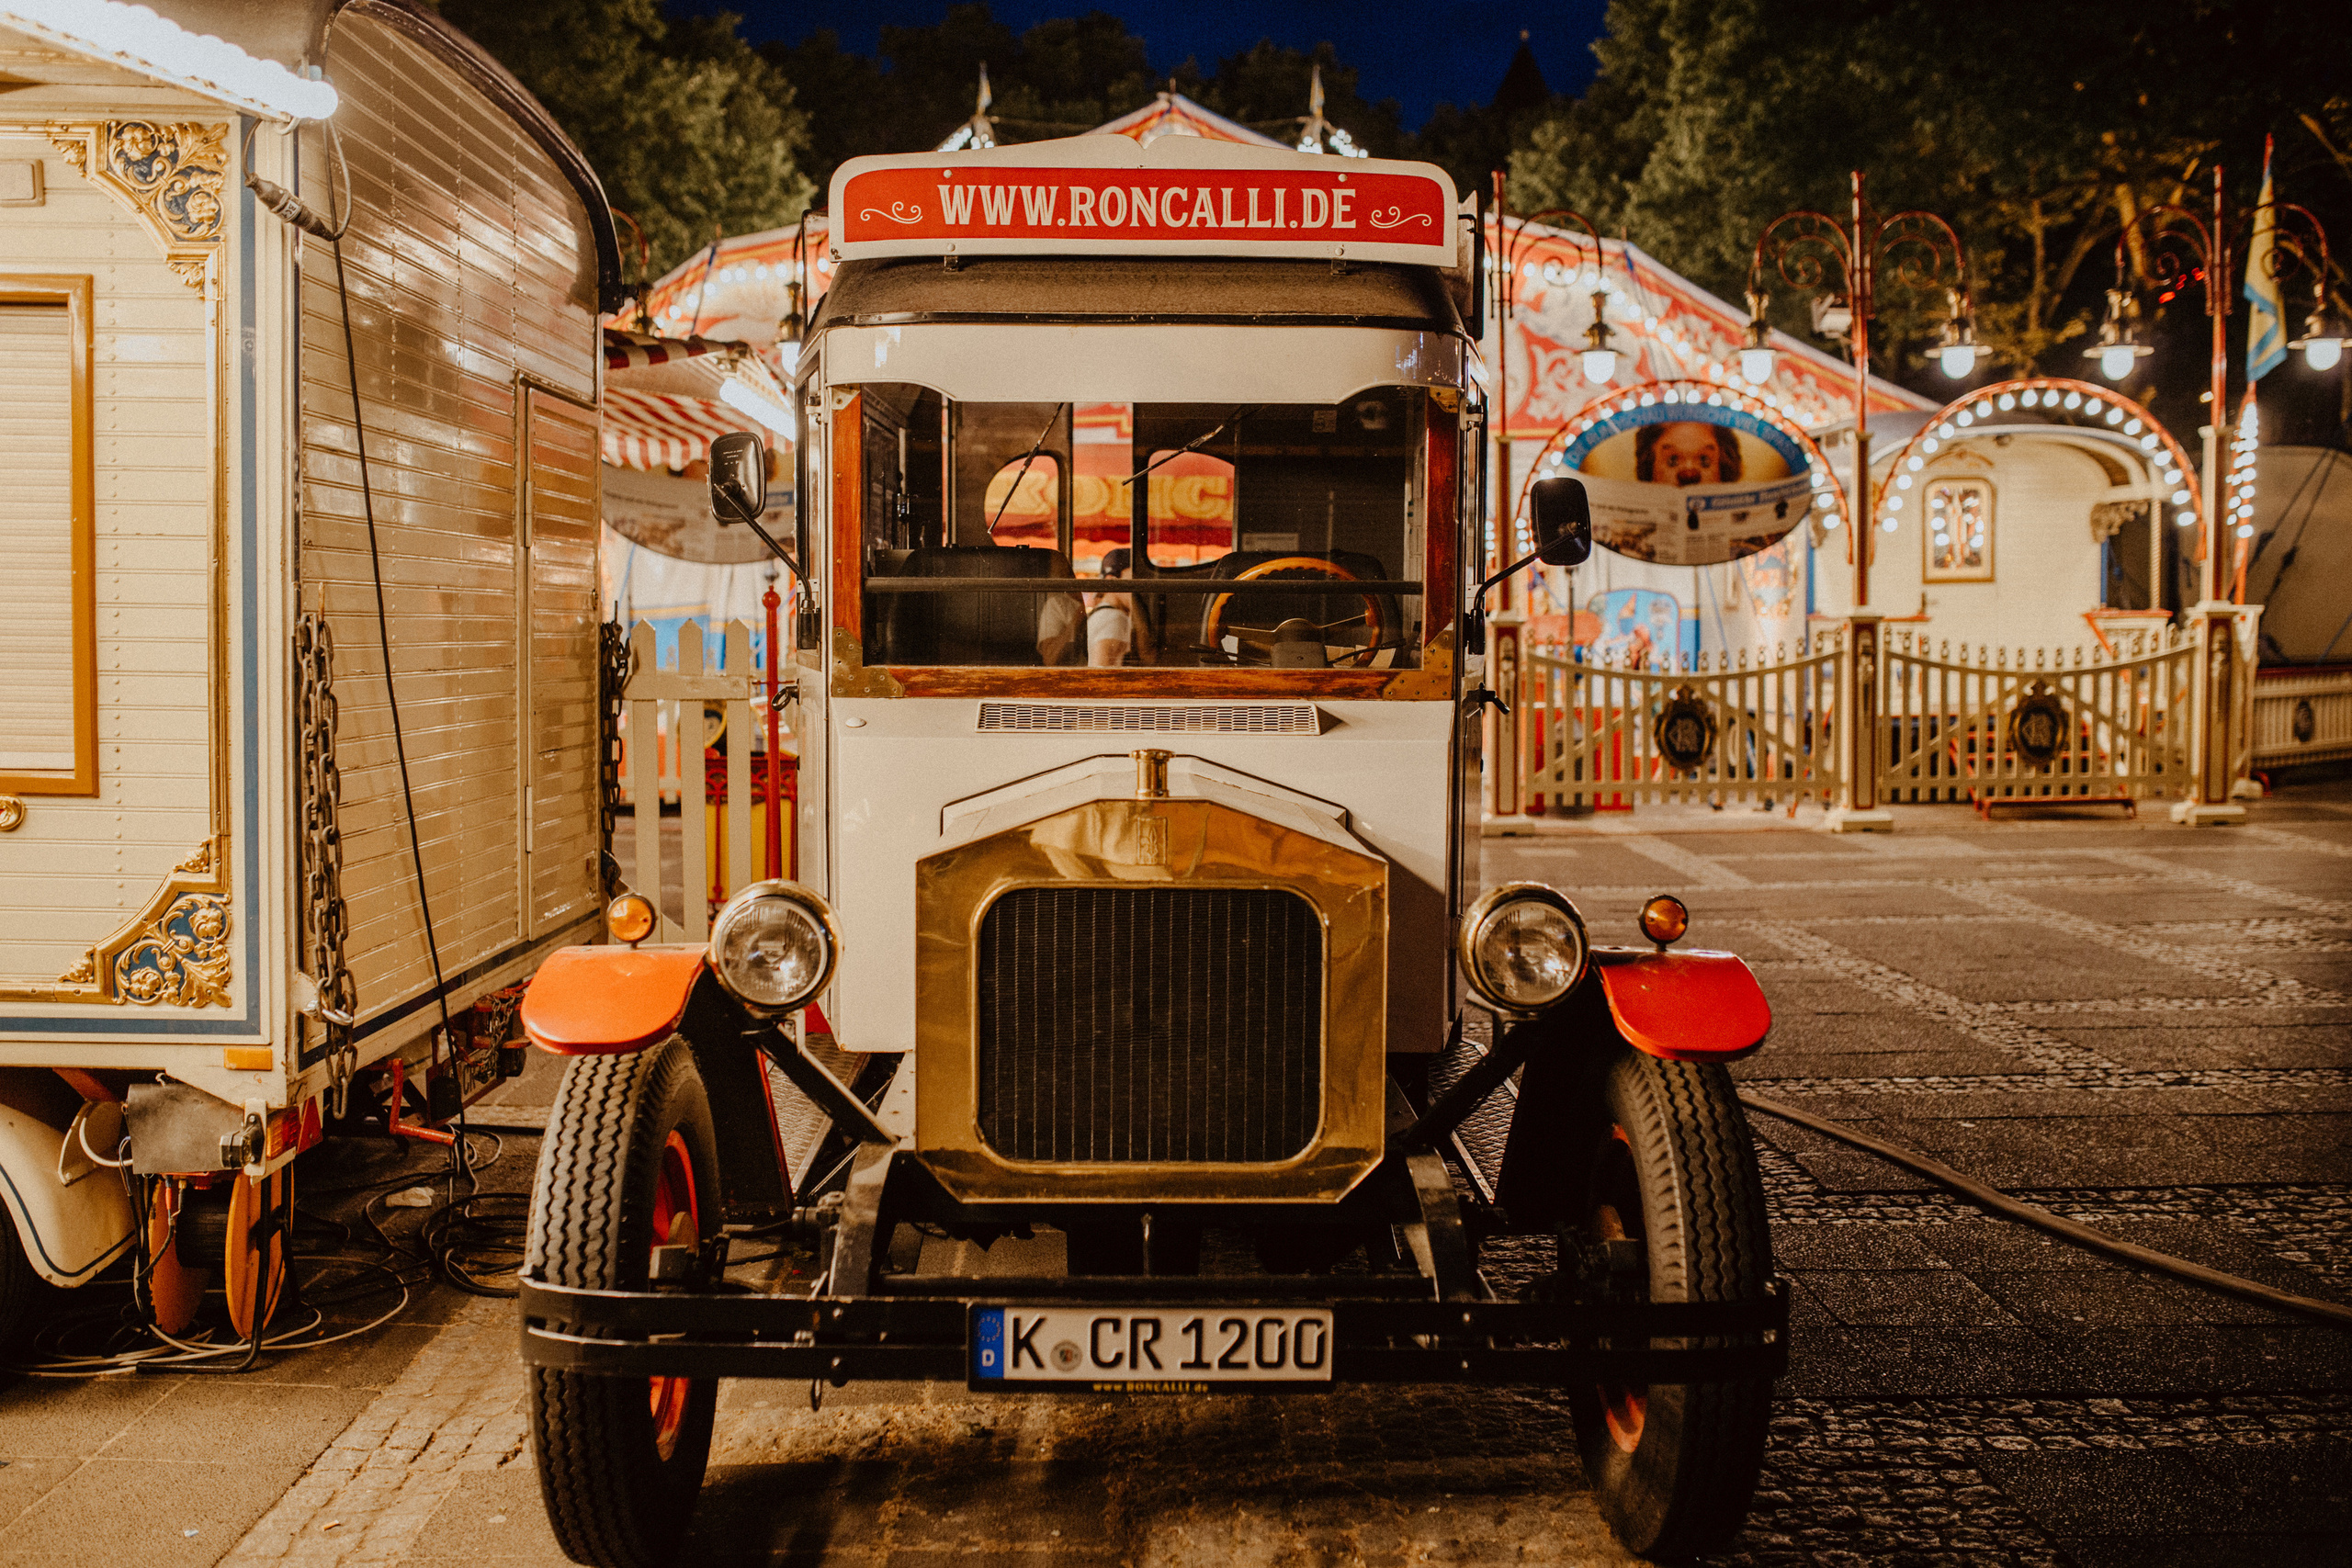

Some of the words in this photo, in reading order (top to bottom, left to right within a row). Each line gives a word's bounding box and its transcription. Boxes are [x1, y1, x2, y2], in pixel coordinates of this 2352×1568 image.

[937, 184, 1357, 229] WWW.RONCALLI.DE
[982, 1349, 995, 1367] D
[1012, 1317, 1046, 1369] K
[1091, 1317, 1163, 1370] CR
[1181, 1316, 1326, 1370] 1200
